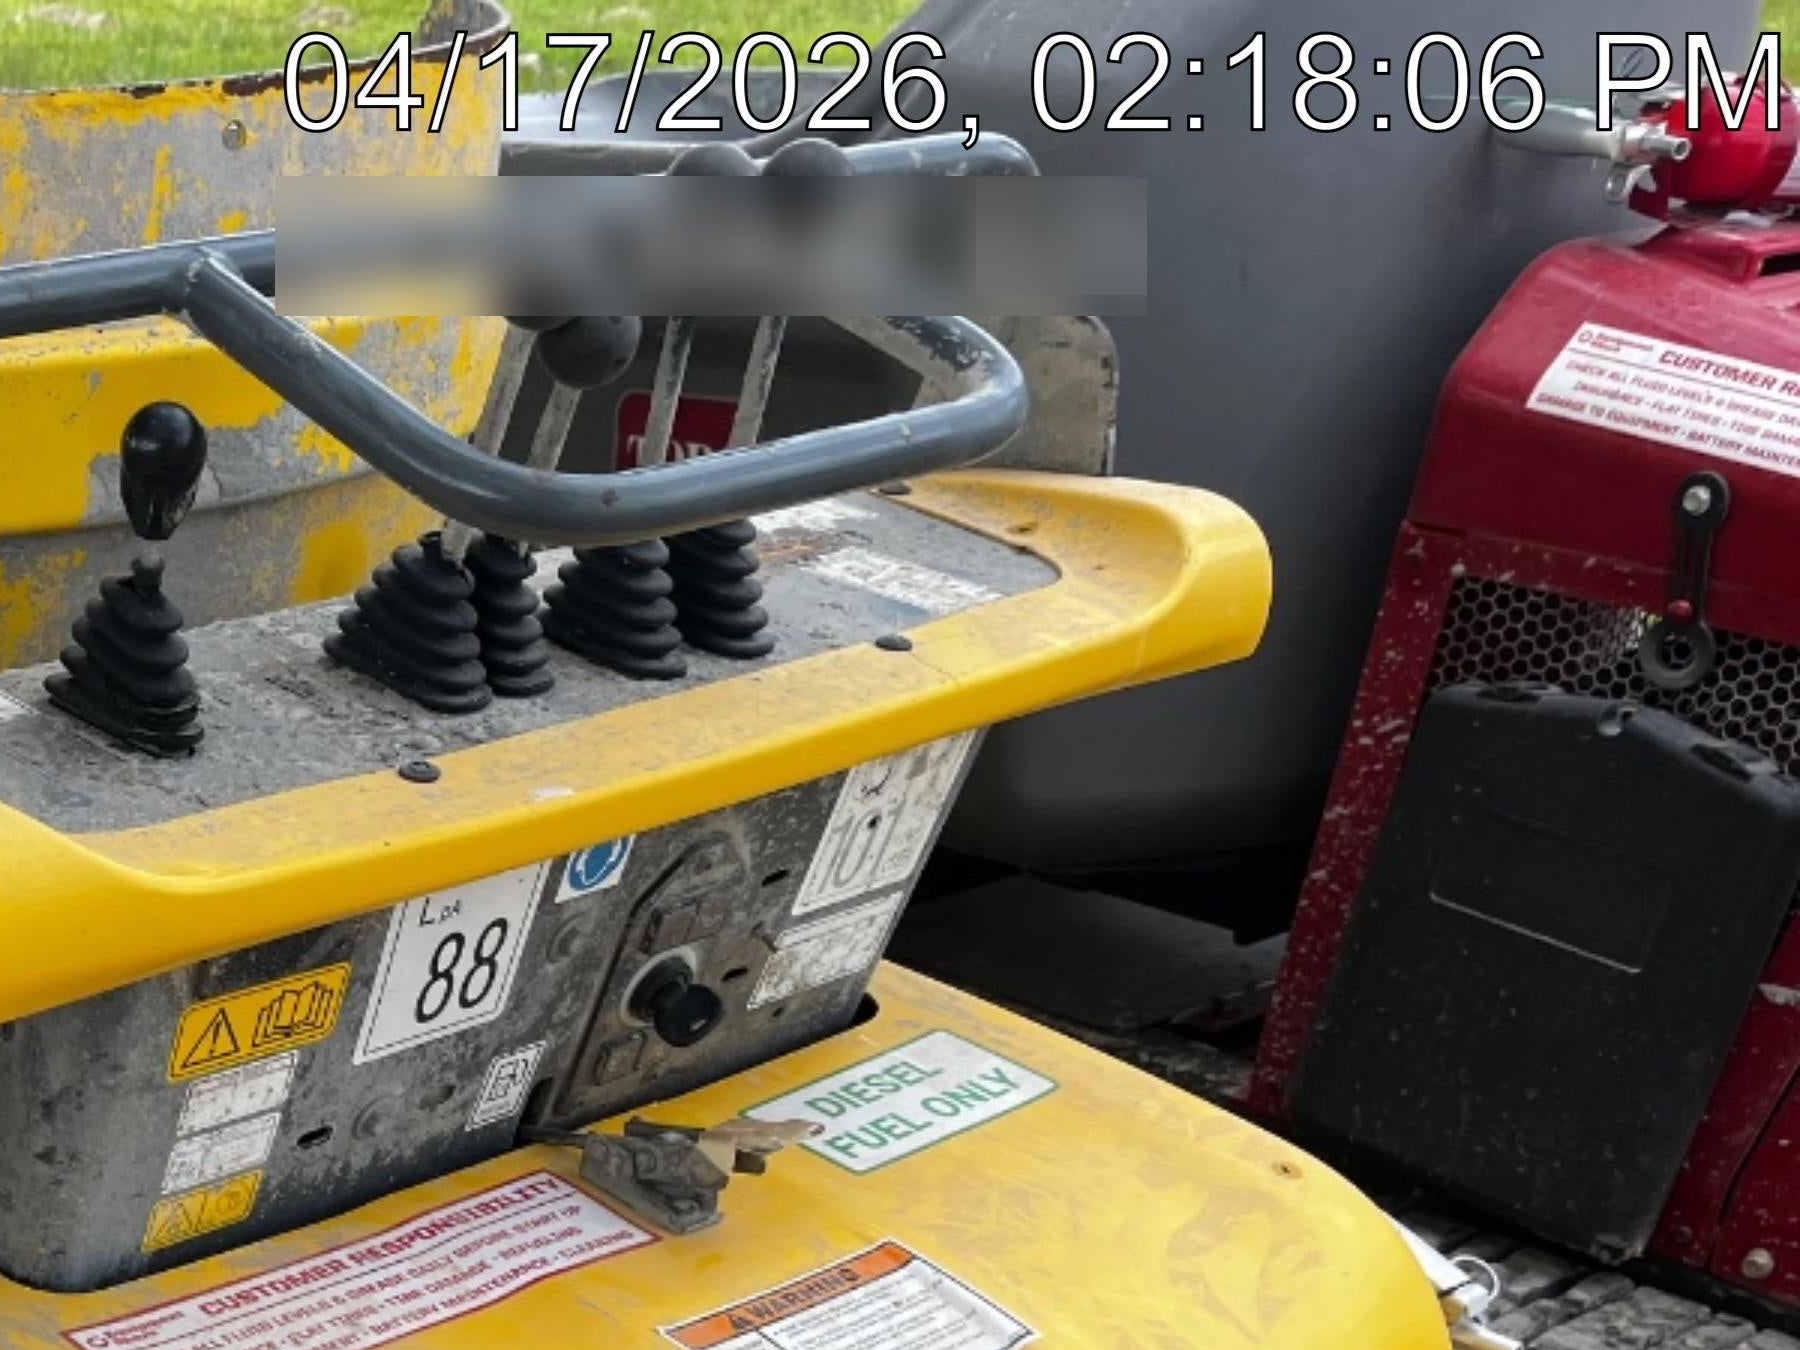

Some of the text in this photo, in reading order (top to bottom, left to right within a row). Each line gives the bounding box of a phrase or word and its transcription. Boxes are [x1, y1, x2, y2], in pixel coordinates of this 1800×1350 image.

[1659, 349, 1777, 390] CUSTOMER
[415, 917, 508, 1023] 88
[806, 1061, 946, 1118] DIESEL
[822, 1067, 1020, 1158] FUEL ONLY
[198, 1178, 560, 1316] CUSTOMER RESPONSIBILITY
[748, 1268, 859, 1318] WARNING
